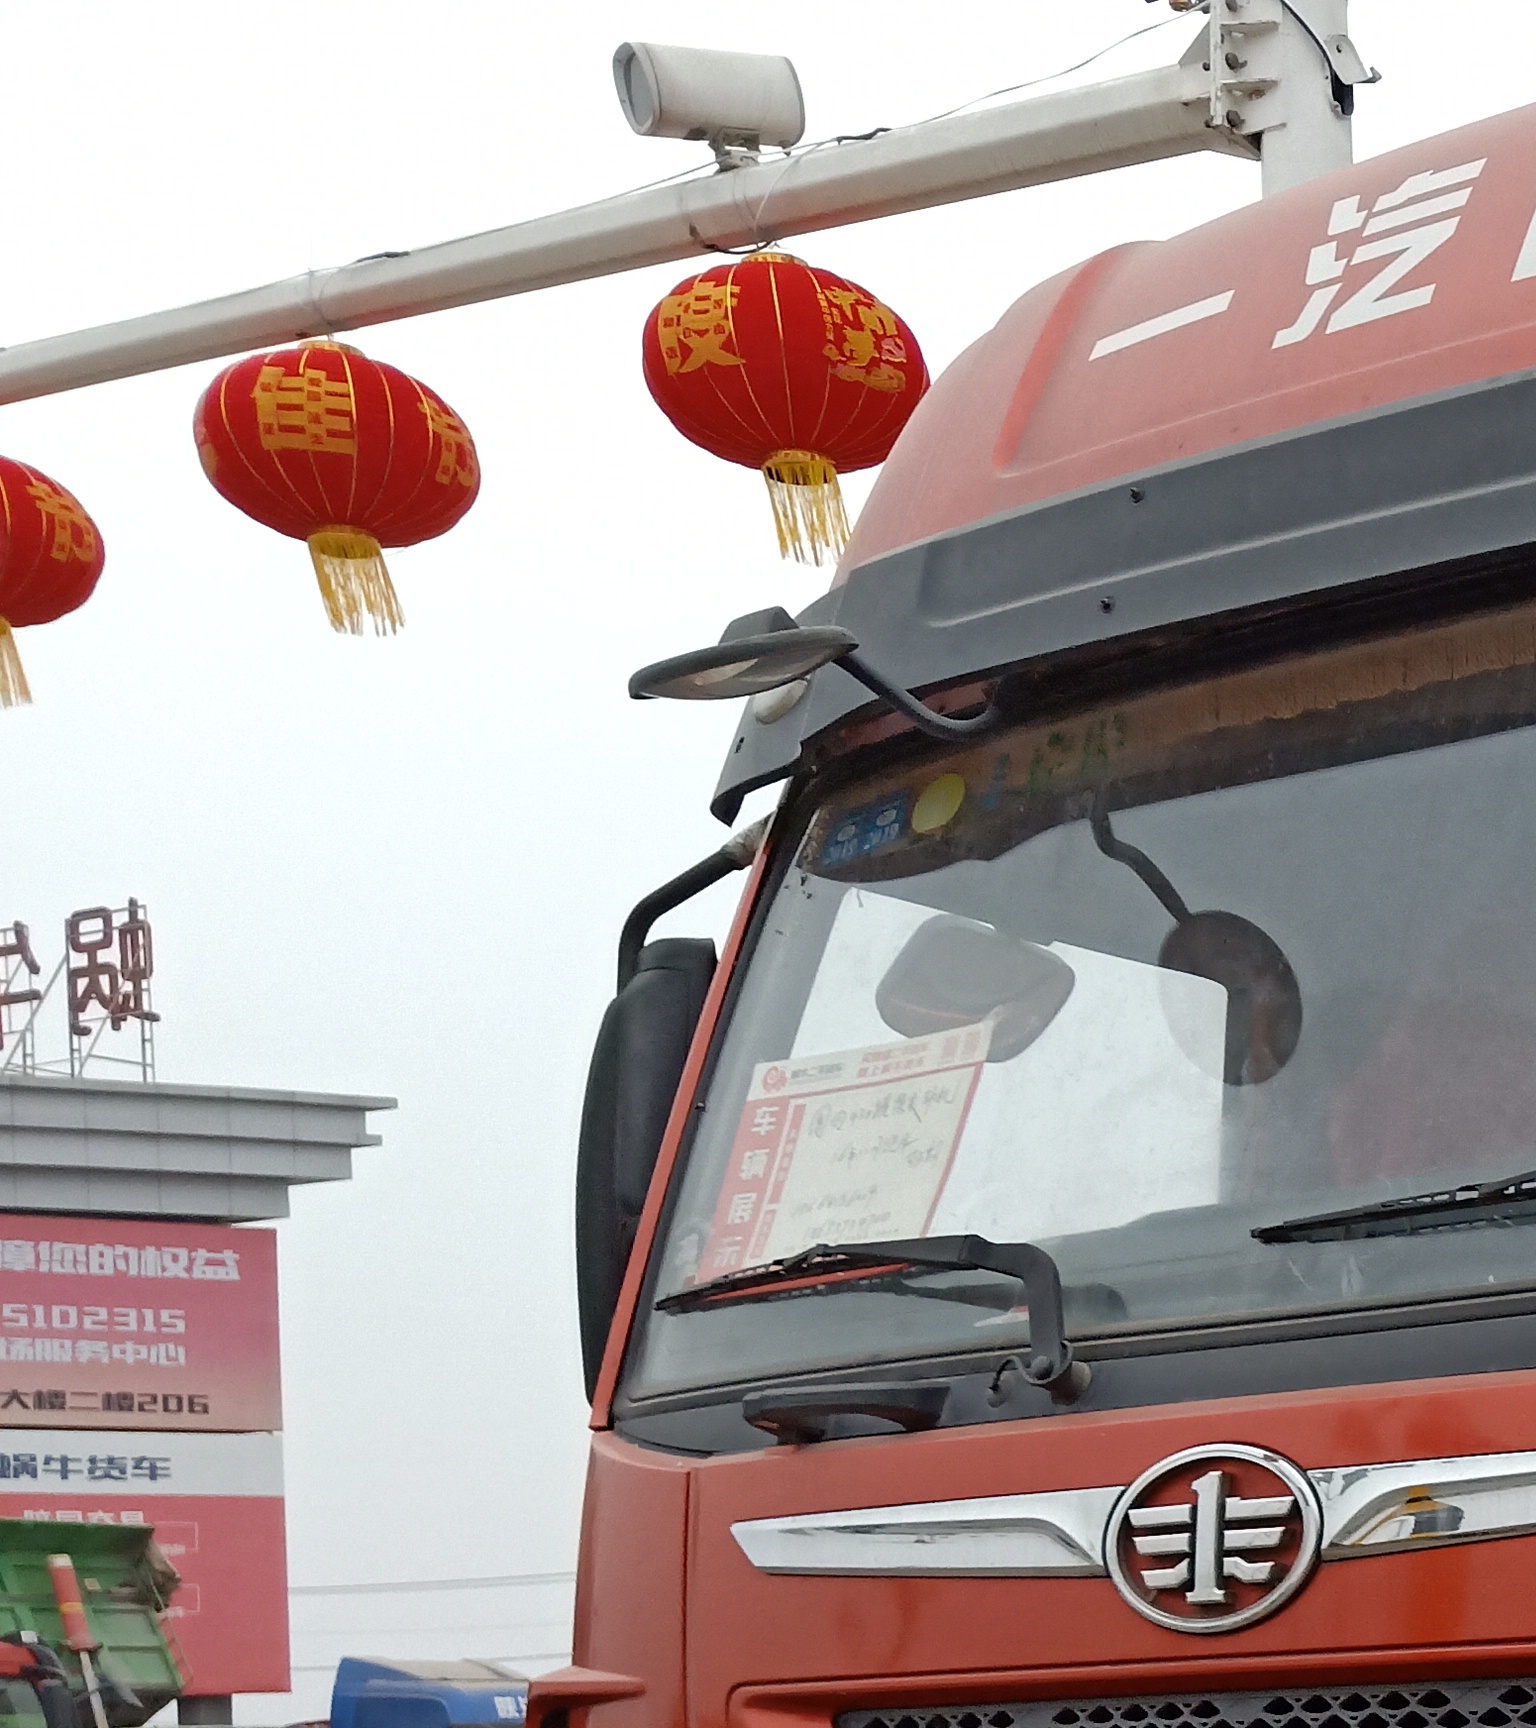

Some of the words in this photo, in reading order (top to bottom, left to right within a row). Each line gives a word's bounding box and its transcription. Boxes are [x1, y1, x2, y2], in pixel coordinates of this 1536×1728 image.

[2, 1303, 186, 1333] 5102315
[0, 1337, 186, 1367] 场服务中心
